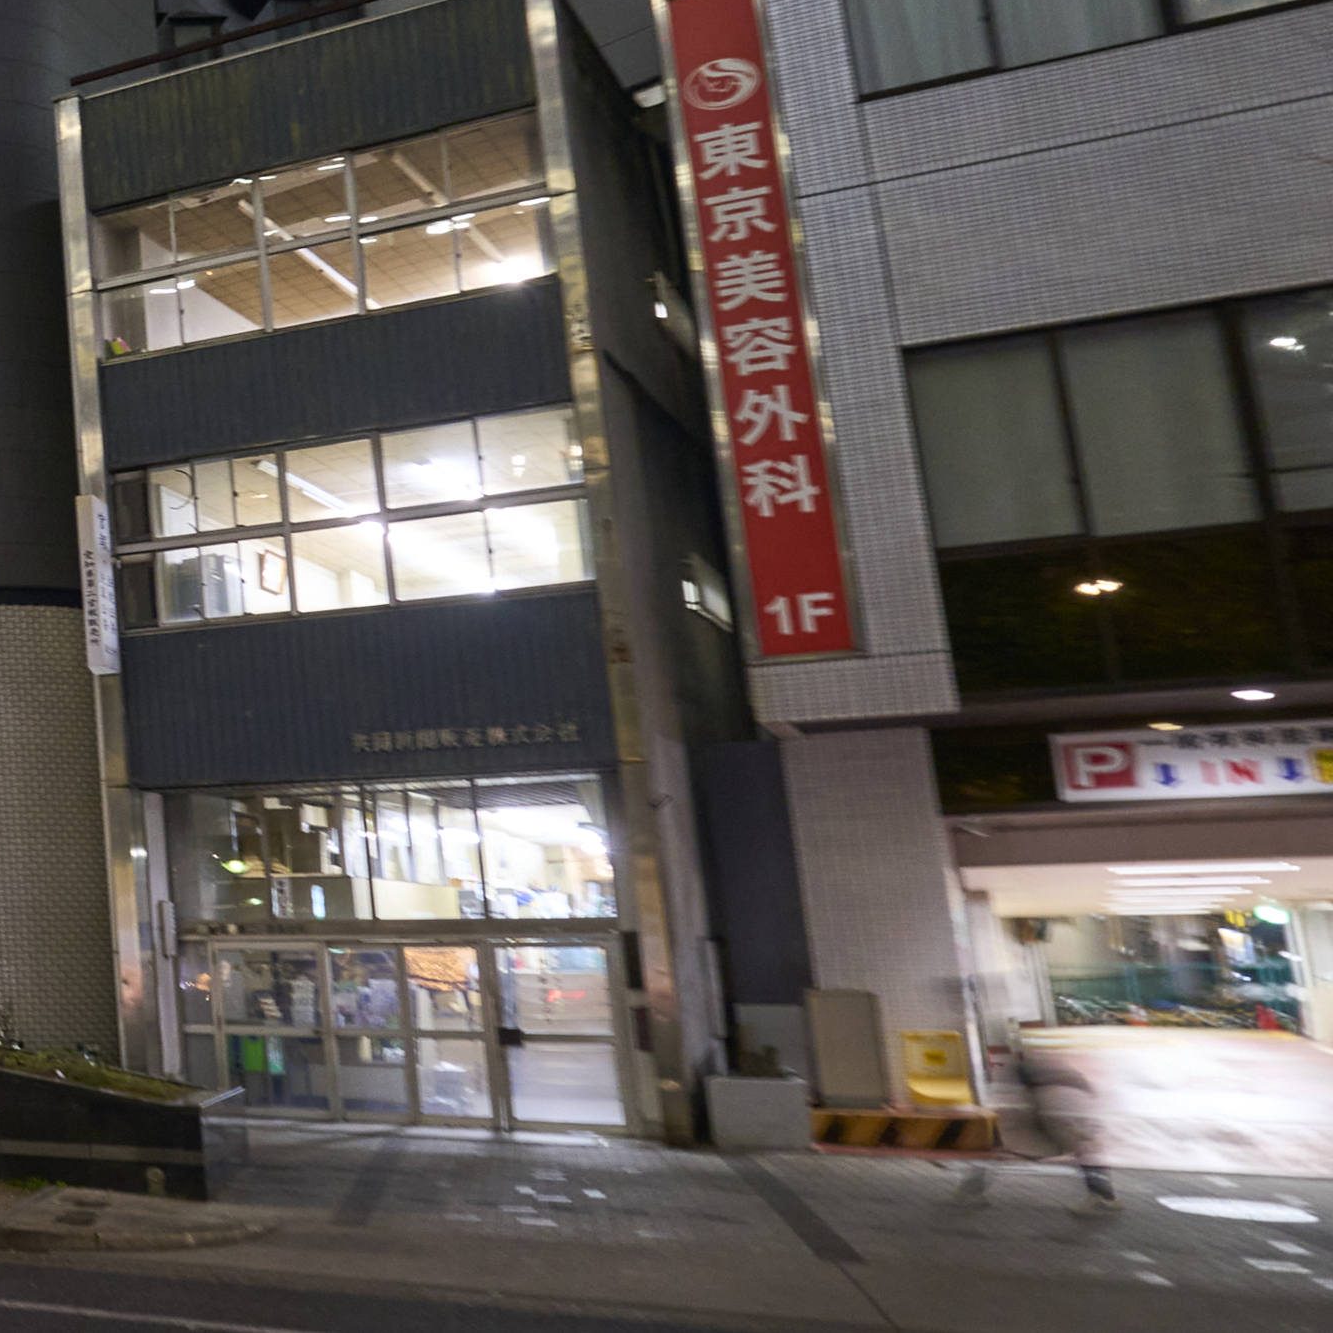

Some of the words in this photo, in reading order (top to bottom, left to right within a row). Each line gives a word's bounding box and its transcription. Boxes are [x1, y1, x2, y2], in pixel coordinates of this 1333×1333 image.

[692, 120, 821, 518] 東京美容外科
[763, 591, 835, 636] 1F
[1072, 745, 1126, 788] P
